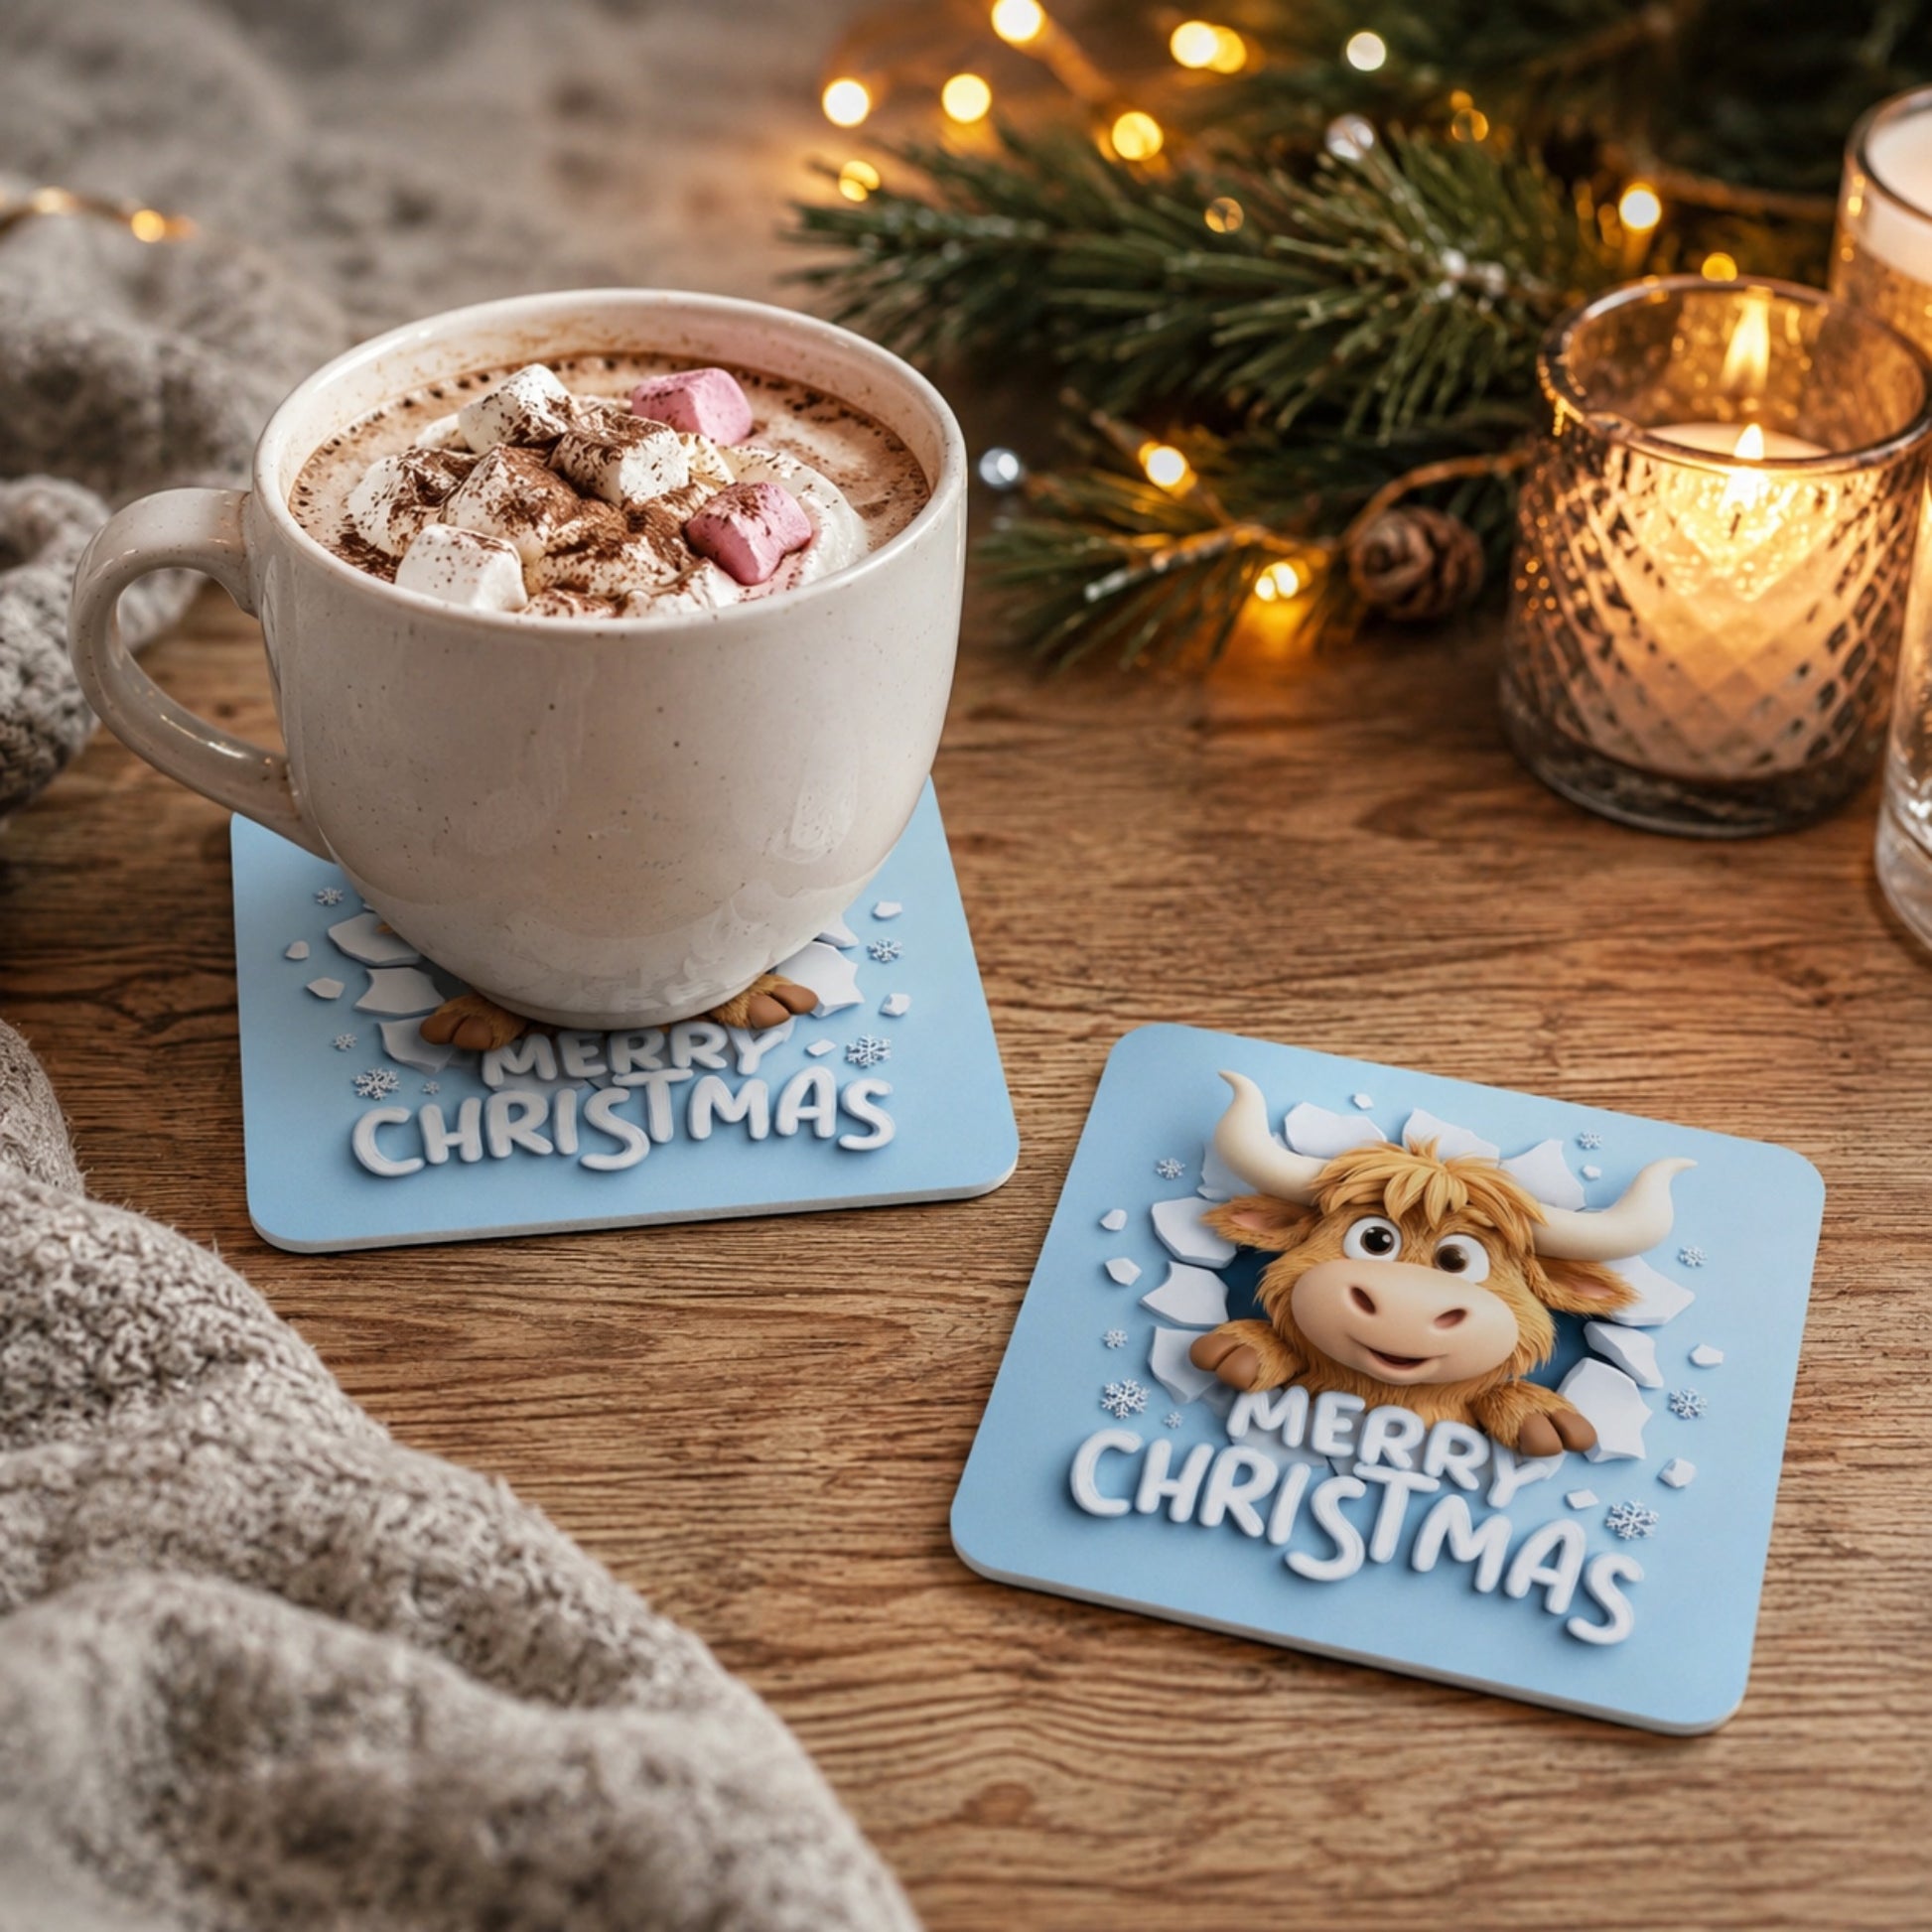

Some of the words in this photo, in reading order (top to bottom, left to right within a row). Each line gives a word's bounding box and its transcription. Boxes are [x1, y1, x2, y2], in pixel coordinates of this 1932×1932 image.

[482, 1022, 785, 1087] MERRY
[352, 1065, 896, 1177] CHRISTMAS
[1226, 1386, 1551, 1508] MERRY
[1070, 1428, 1644, 1646] CHRISTMAS
